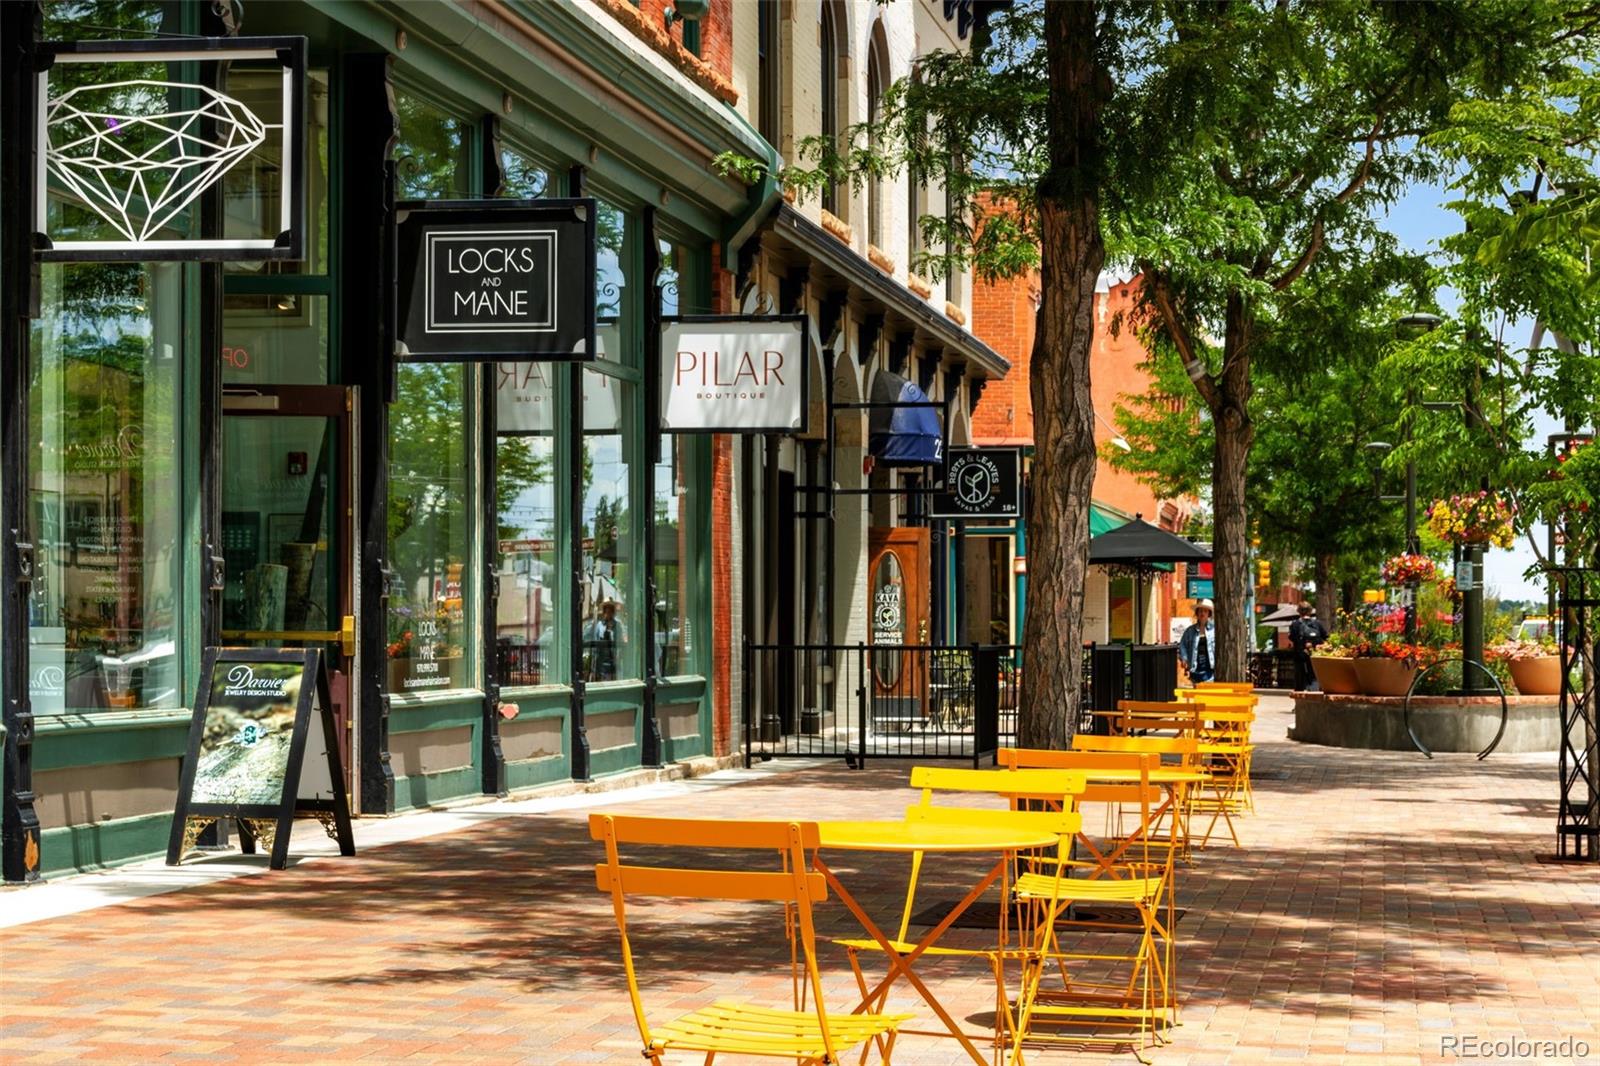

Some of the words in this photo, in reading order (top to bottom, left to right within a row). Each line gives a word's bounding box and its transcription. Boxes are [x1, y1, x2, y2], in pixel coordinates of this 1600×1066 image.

[448, 247, 534, 273] LOCKS
[481, 277, 502, 287] AND
[454, 291, 528, 316] MANE
[676, 351, 785, 386] PILAR
[696, 392, 766, 400] BOUTIQUE
[949, 457, 966, 484] ROOTS
[966, 453, 974, 462] &
[976, 454, 999, 484] LEAVES
[875, 593, 899, 602] KAVA
[225, 665, 288, 690] Darvier
